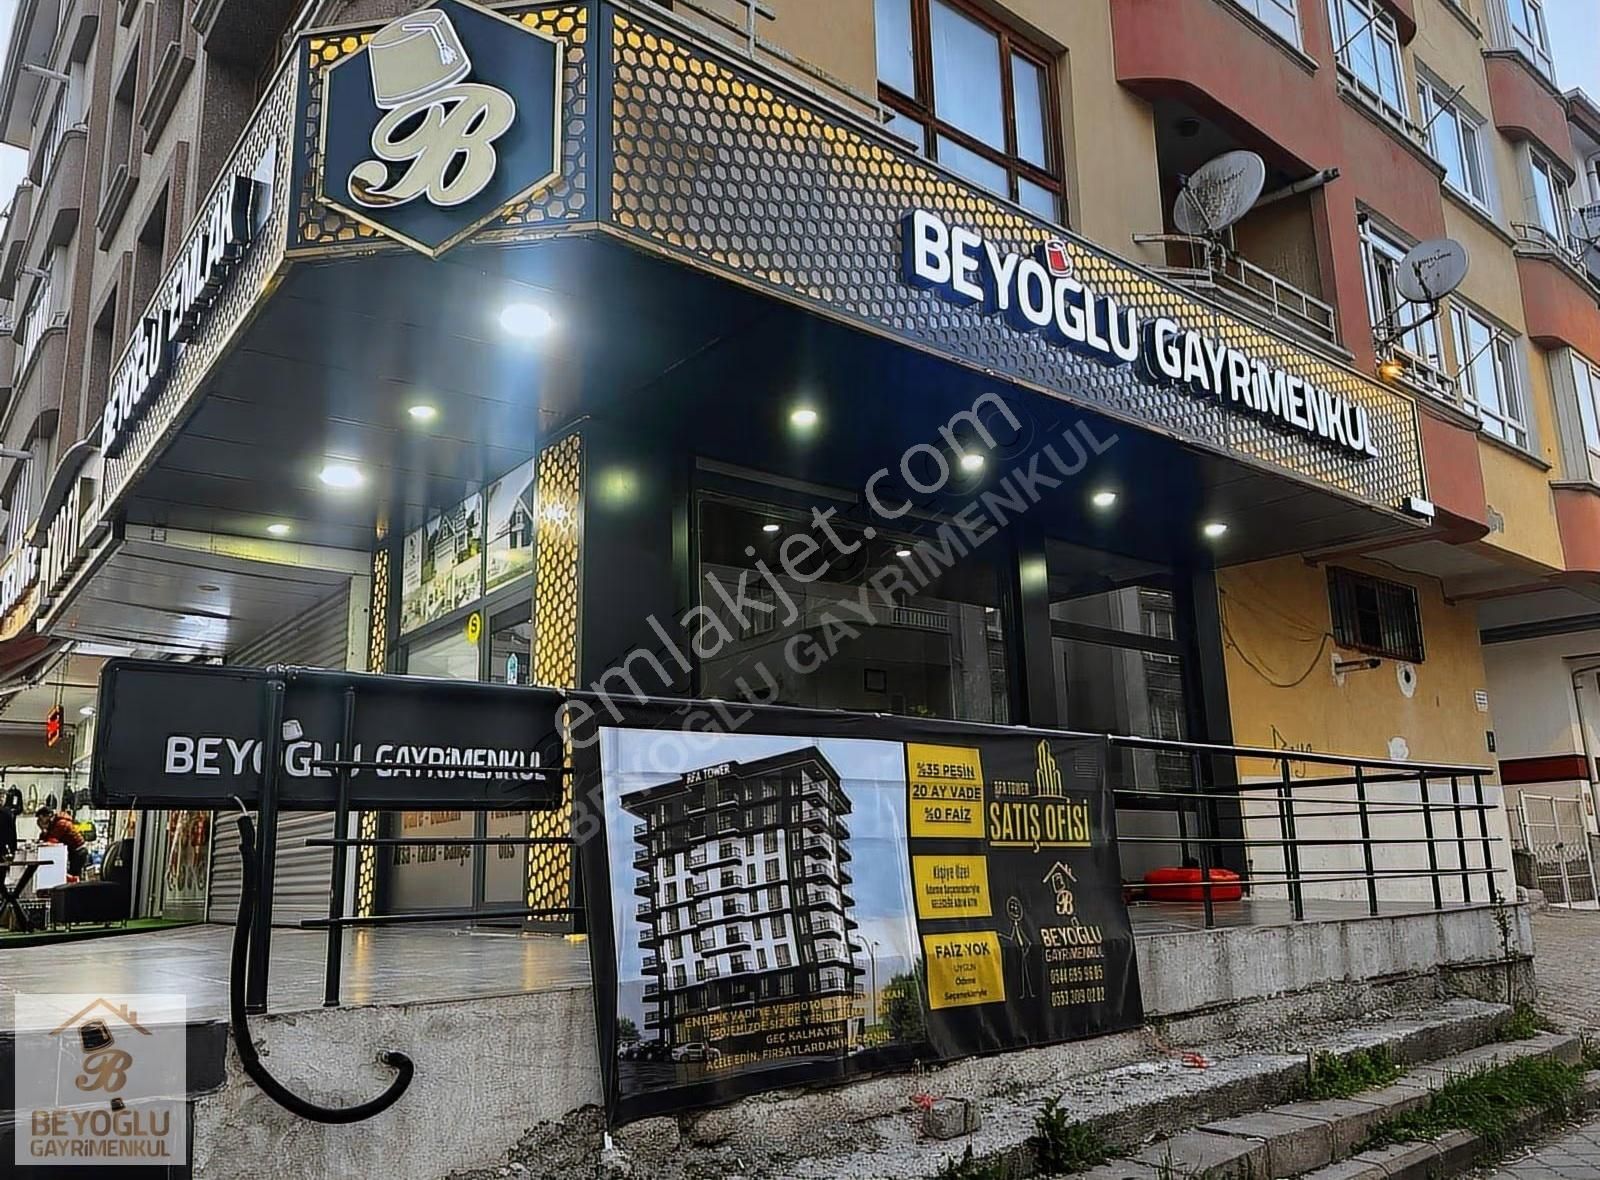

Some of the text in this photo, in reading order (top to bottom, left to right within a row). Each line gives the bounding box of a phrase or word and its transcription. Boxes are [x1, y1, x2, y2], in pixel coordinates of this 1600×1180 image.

[913, 784, 927, 798] 20
[931, 785, 947, 798] AY
[952, 786, 982, 799] VADE
[945, 805, 972, 820] FAİZ
[990, 799, 1090, 853] SATIŞ OFİSİ
[935, 942, 990, 959] FAİZ YOK
